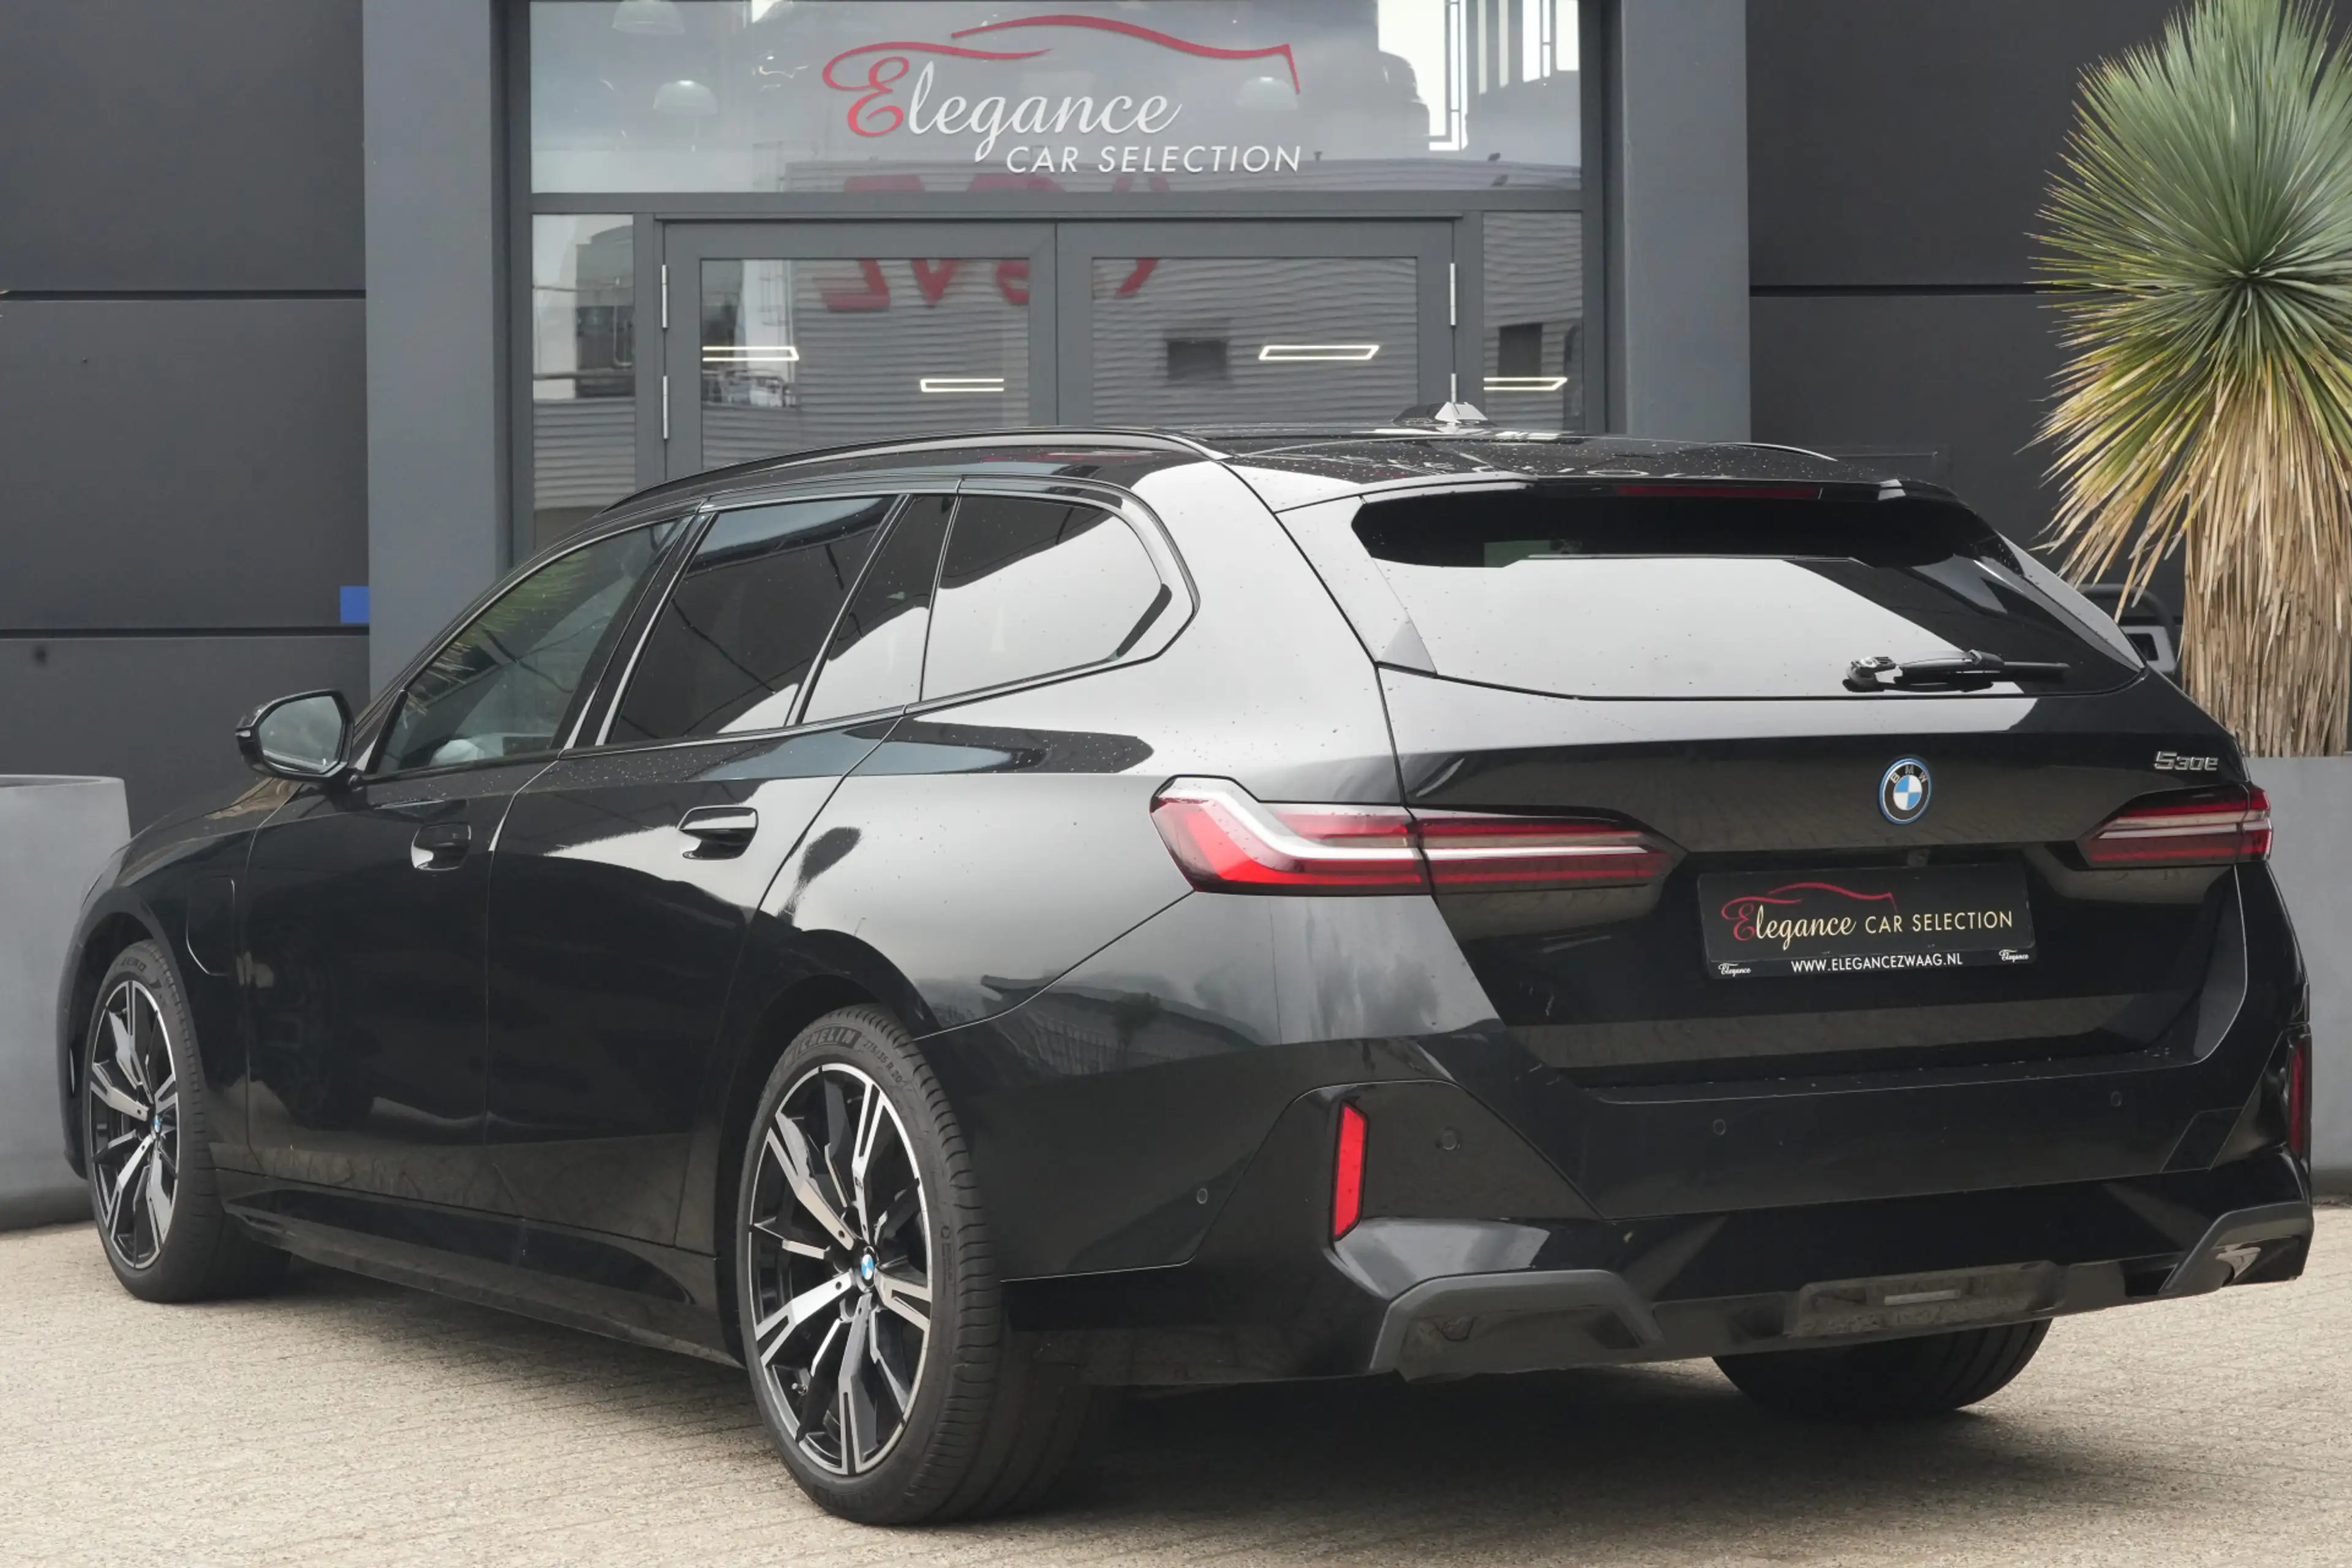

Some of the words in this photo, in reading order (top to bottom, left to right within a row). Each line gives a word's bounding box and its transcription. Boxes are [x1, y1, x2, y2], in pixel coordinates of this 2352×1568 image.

[822, 42, 1182, 162] Elegance
[1006, 146, 1079, 173] CAR
[1098, 145, 1302, 173] SELECTION
[1721, 896, 1856, 951] Elegance
[1865, 915, 1902, 934] CAR
[1912, 910, 2013, 932] SELECTION
[1791, 953, 1963, 973] WWW.ELEGANCEZWAAG.NL
